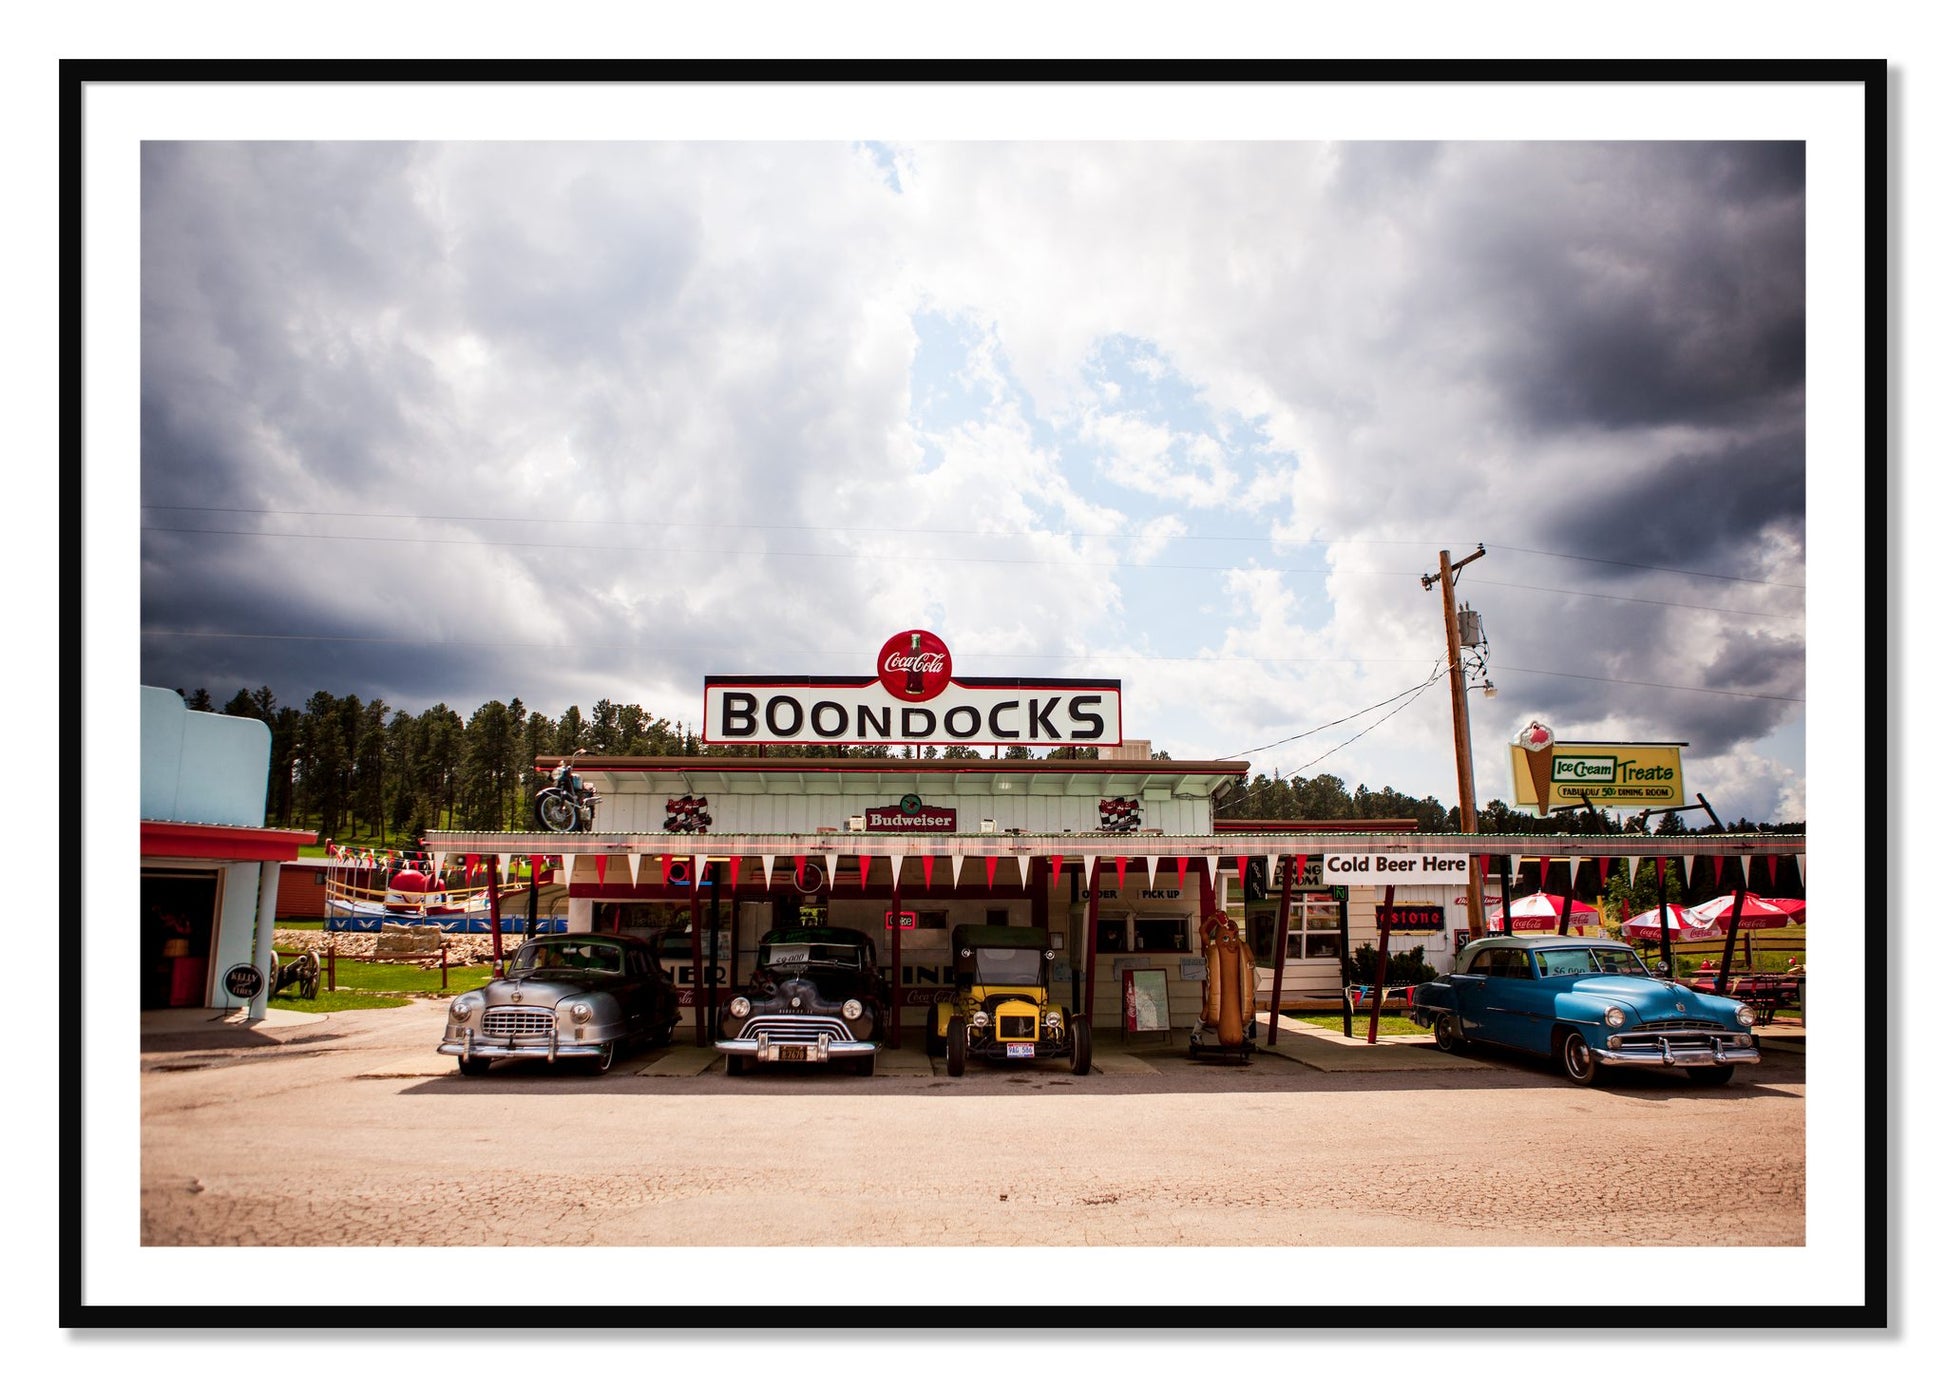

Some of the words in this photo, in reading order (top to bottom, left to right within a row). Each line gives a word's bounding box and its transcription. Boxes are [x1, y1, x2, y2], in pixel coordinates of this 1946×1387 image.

[884, 651, 946, 673] Coca-Cola
[721, 691, 1105, 739] BOONDOCKS
[1557, 761, 1573, 775] Ice
[1574, 761, 1612, 777] Cream
[1618, 760, 1674, 783] Treats
[1562, 788, 1600, 796] FABULOUS
[1618, 788, 1643, 797] DINING
[1645, 788, 1669, 797] ROOM
[869, 814, 952, 826] Budweiser
[1327, 856, 1370, 872] Cold
[1376, 856, 1417, 872] Beer
[1422, 856, 1466, 872] Here
[1081, 890, 1117, 899] ODER
[1142, 890, 1164, 899] PICK
[1166, 890, 1180, 899] UP
